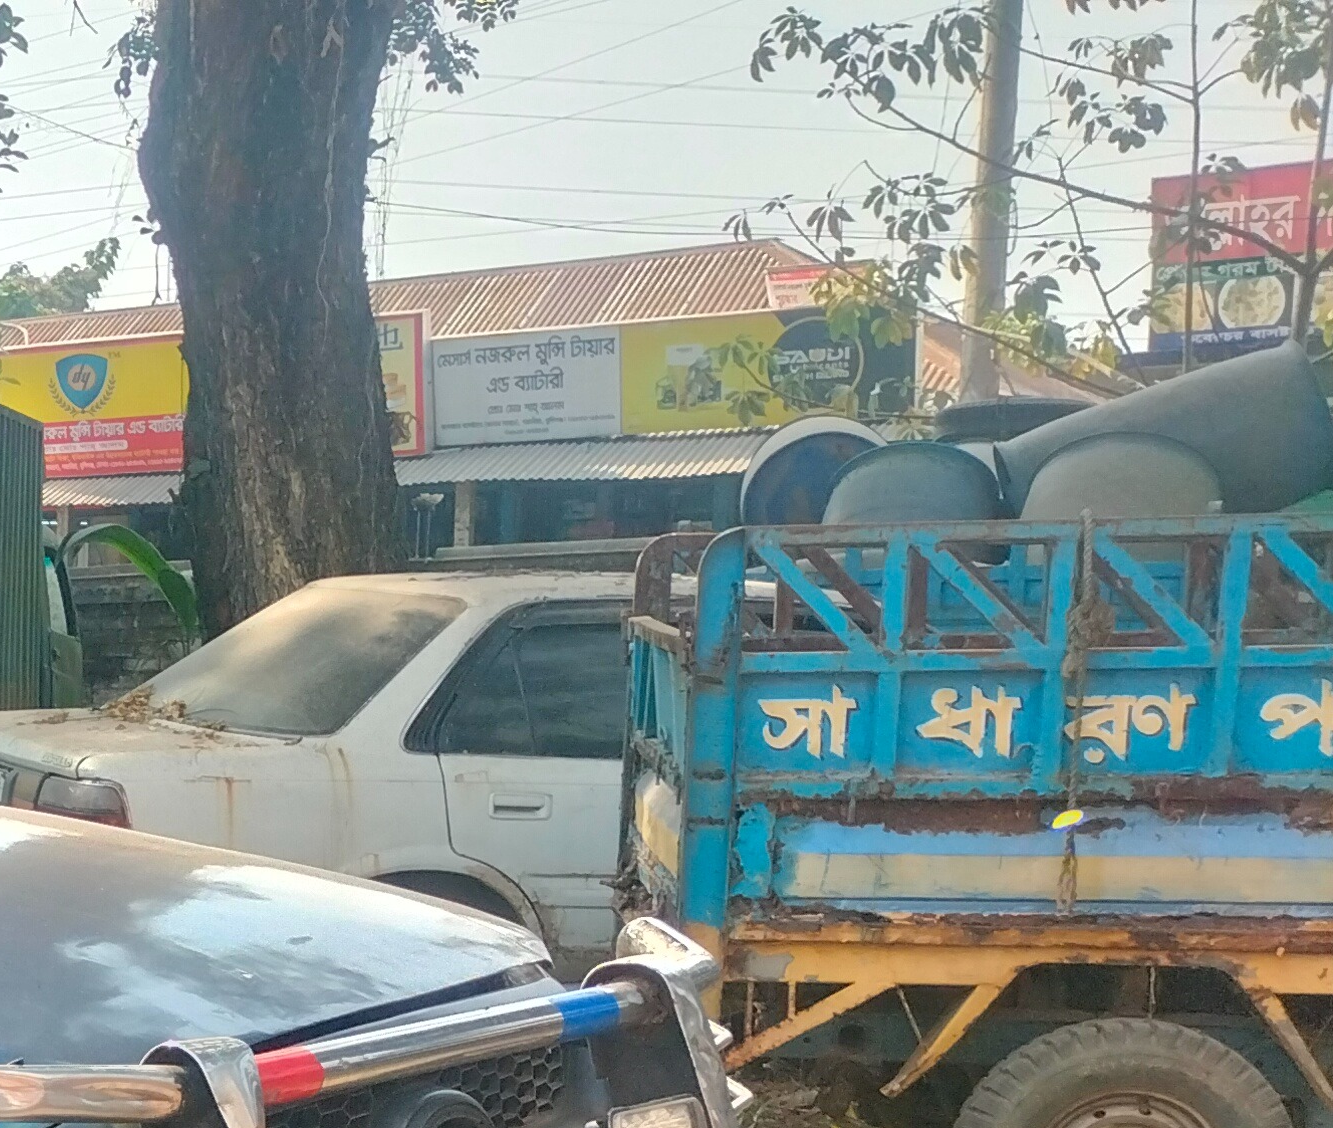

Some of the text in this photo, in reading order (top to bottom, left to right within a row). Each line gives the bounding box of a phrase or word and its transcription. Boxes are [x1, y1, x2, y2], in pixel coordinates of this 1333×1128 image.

[475, 343, 532, 364] নজরুল
[570, 334, 617, 358] টায়ার
[93, 420, 125, 438] টায়ার
